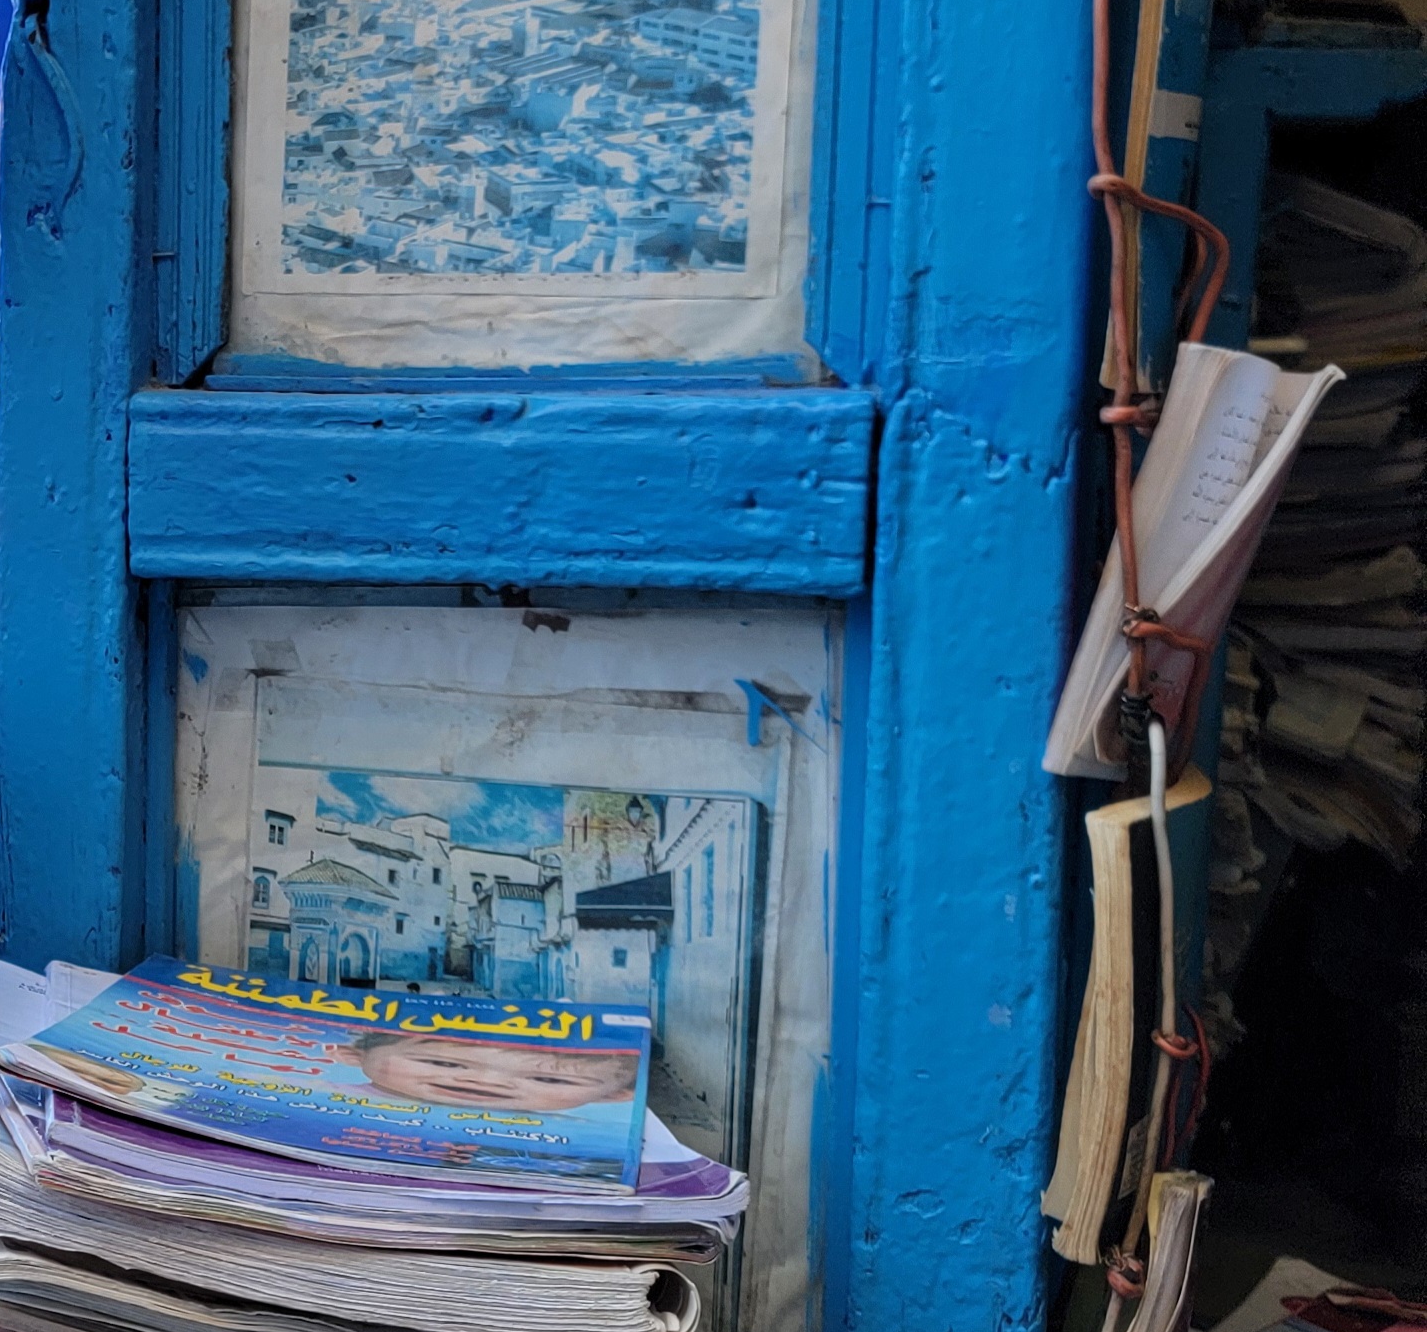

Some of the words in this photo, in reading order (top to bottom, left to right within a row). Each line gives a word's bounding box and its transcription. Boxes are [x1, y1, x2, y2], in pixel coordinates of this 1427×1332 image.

[176, 964, 399, 1023] المطمئنة
[399, 1004, 593, 1042] النفس
[328, 1091, 431, 1115] السعادة
